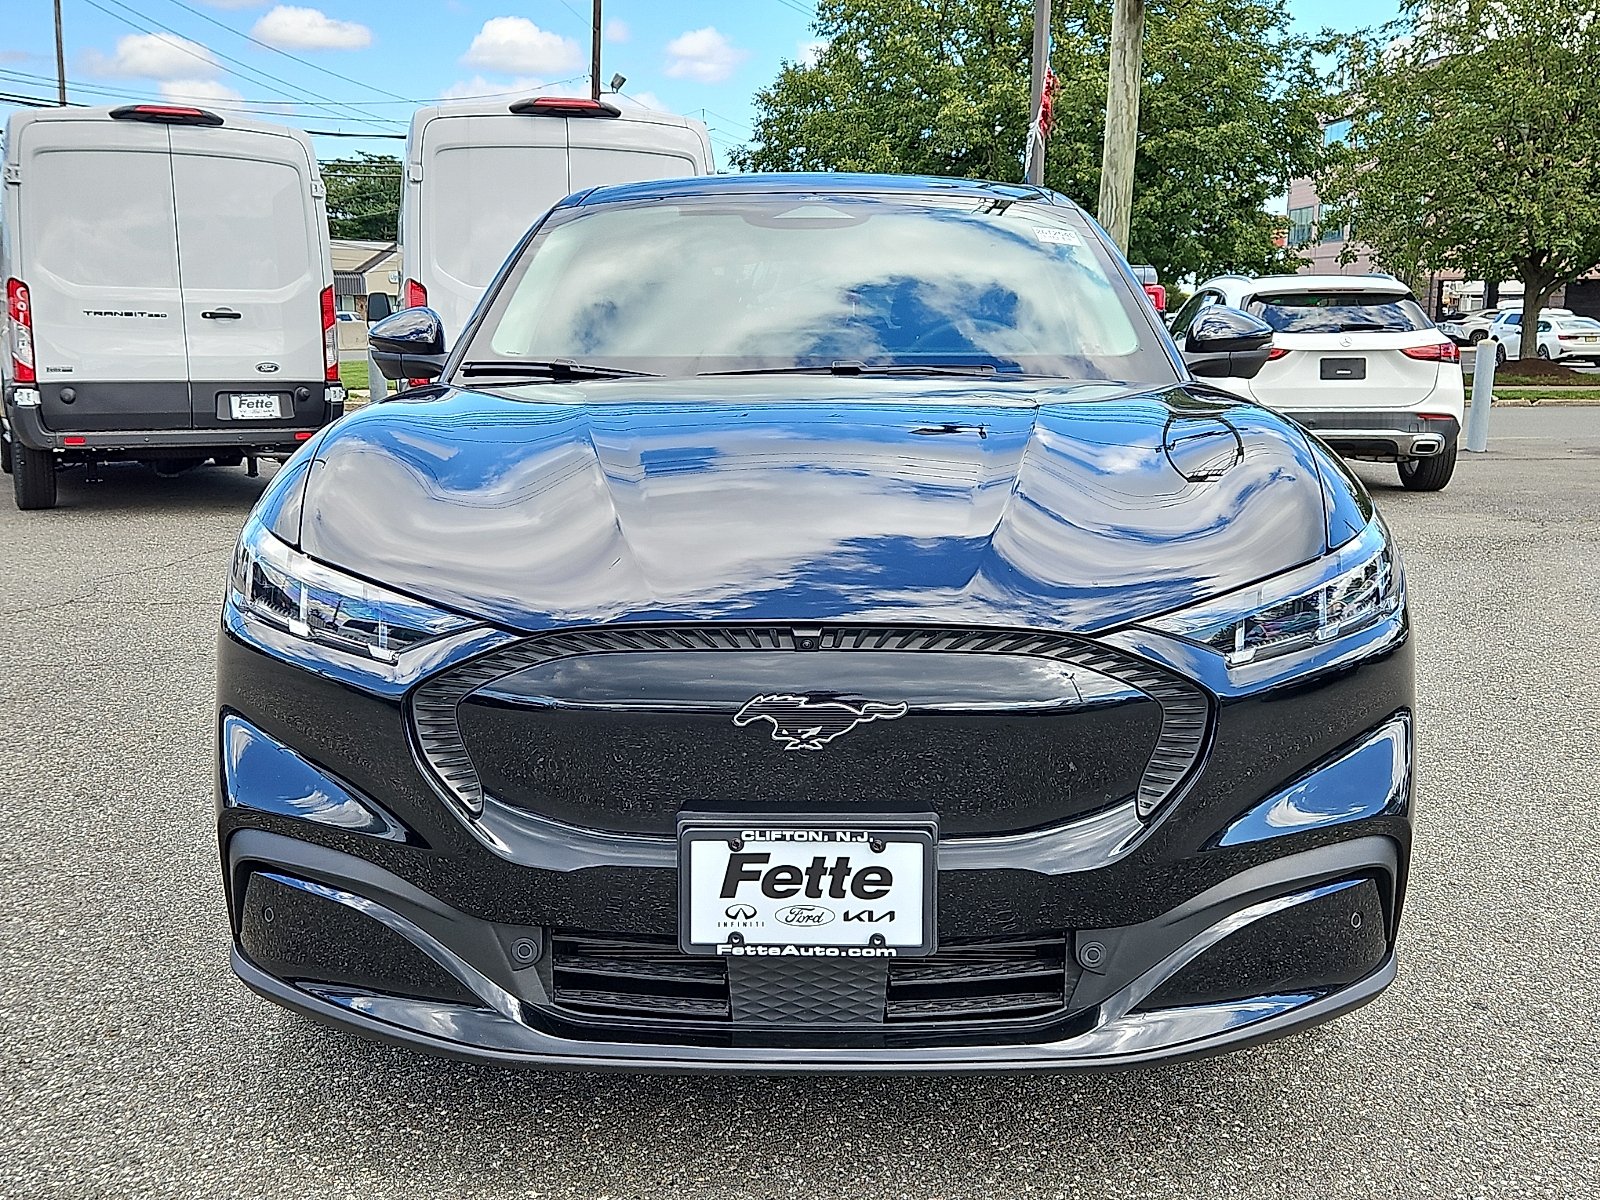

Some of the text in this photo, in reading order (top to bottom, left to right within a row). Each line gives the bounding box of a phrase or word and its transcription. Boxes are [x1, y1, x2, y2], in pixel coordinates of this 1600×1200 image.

[238, 398, 273, 409] Fette
[741, 830, 875, 843] CLIFTON, N.J.
[719, 852, 893, 900] Fette
[783, 905, 826, 925] Ford
[843, 909, 896, 923] KIA
[716, 944, 897, 957] FetteAuto.com
